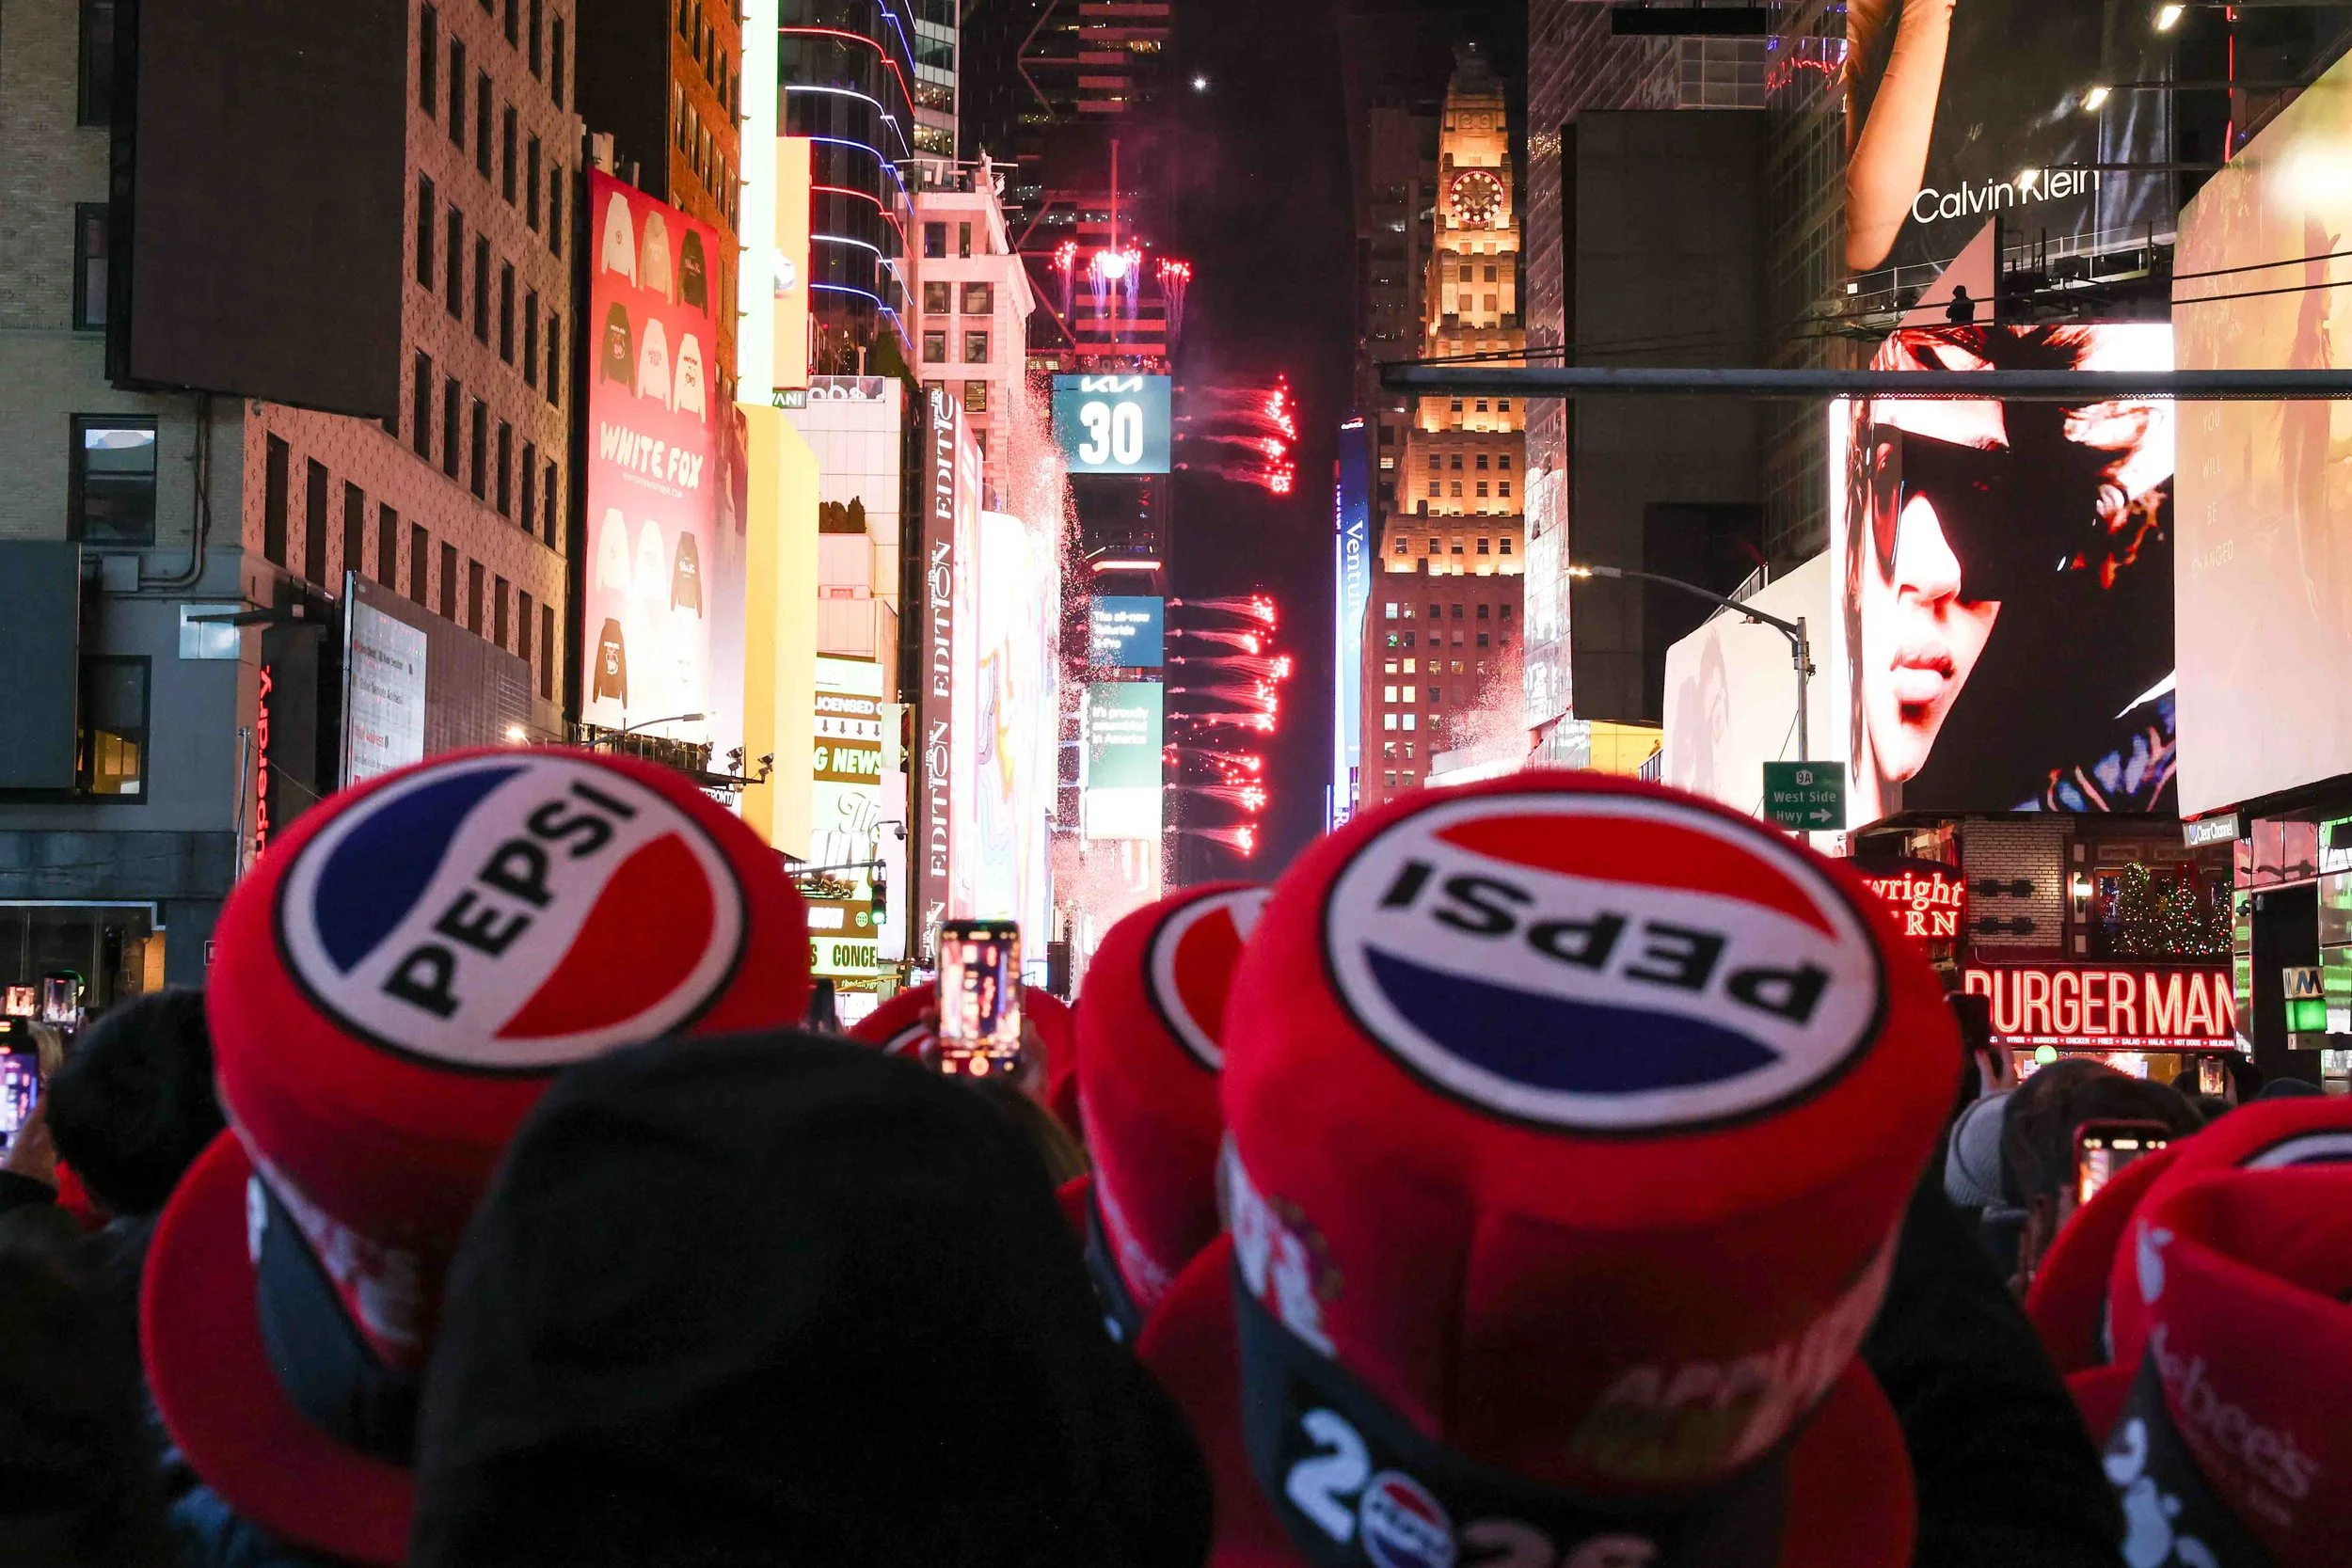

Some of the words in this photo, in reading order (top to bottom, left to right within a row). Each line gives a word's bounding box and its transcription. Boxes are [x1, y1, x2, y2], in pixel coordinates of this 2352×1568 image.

[1912, 178, 2013, 224] Calvin
[2021, 161, 2100, 205] Klein
[1079, 402, 1143, 466] 30
[2202, 407, 2220, 435] YOU
[600, 420, 665, 479] WHITE
[667, 447, 704, 489] FOX
[2202, 454, 2221, 480] WILL
[2206, 501, 2217, 525] BE
[1346, 519, 1364, 625] Venture
[2192, 540, 2234, 578] CHANGED
[933, 538, 951, 698] EDITION
[1092, 611, 1113, 623] The
[256, 665, 272, 860] uperdry.
[814, 746, 829, 771] G
[1798, 772, 1811, 784] 9A
[930, 718, 948, 878] EDITION
[1773, 790, 1804, 802] West
[1809, 790, 1836, 802] Side
[1776, 810, 1803, 824] Hwy
[2197, 824, 2211, 841] Clear
[2211, 819, 2233, 839] Channel
[379, 778, 641, 1022] PEPSI
[1891, 911, 1958, 936] RN
[833, 944, 879, 968] CONCE
[1378, 859, 1833, 1026] PEPSI
